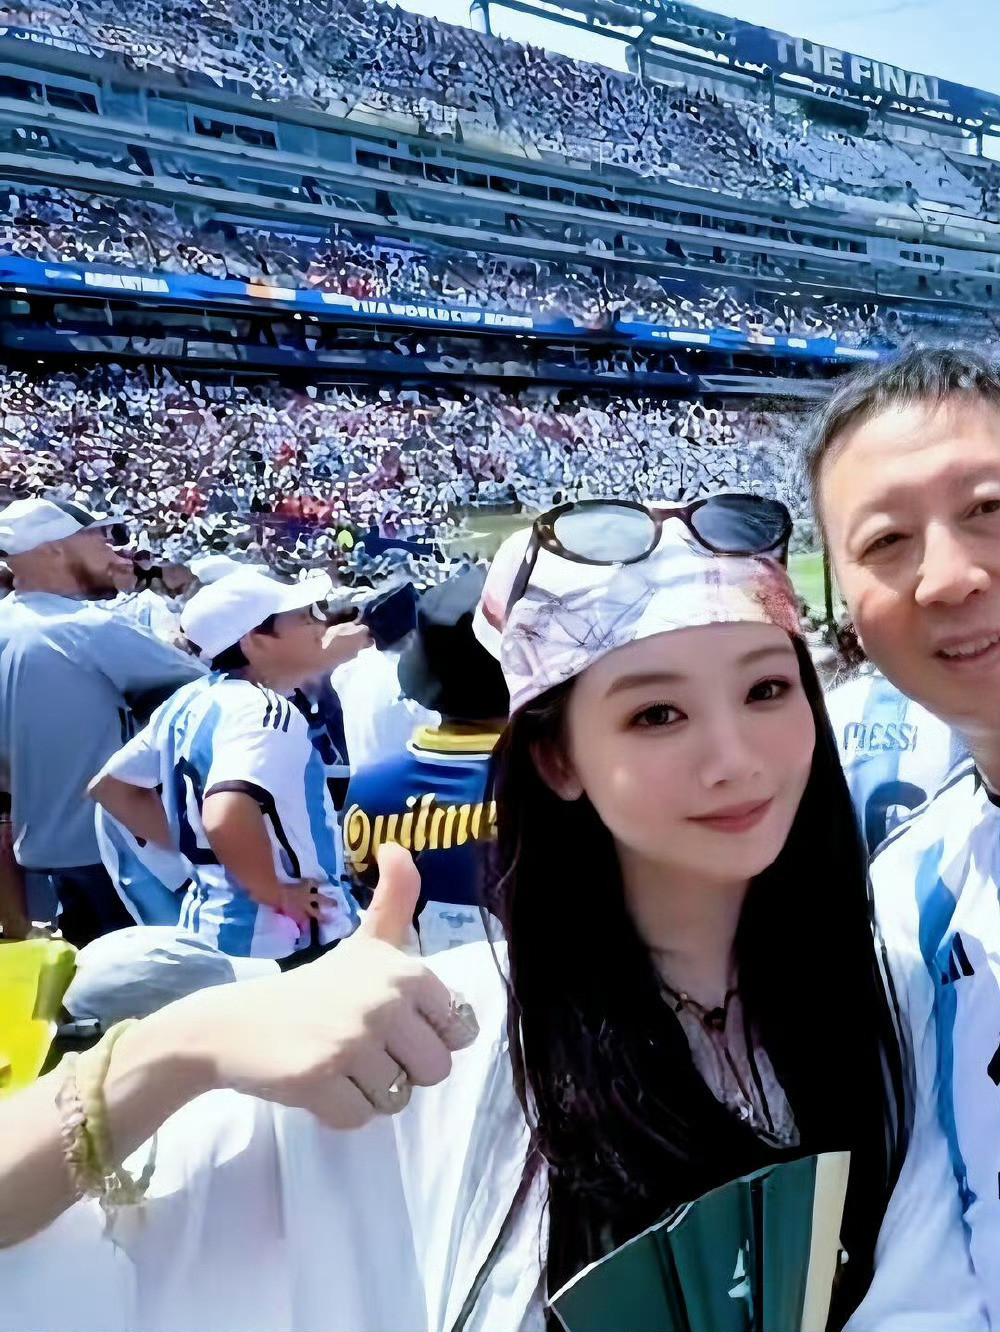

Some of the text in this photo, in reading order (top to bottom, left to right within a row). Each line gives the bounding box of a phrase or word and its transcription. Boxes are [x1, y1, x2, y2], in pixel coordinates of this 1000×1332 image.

[771, 34, 949, 107] THE FINAL
[843, 721, 918, 752] MESSI
